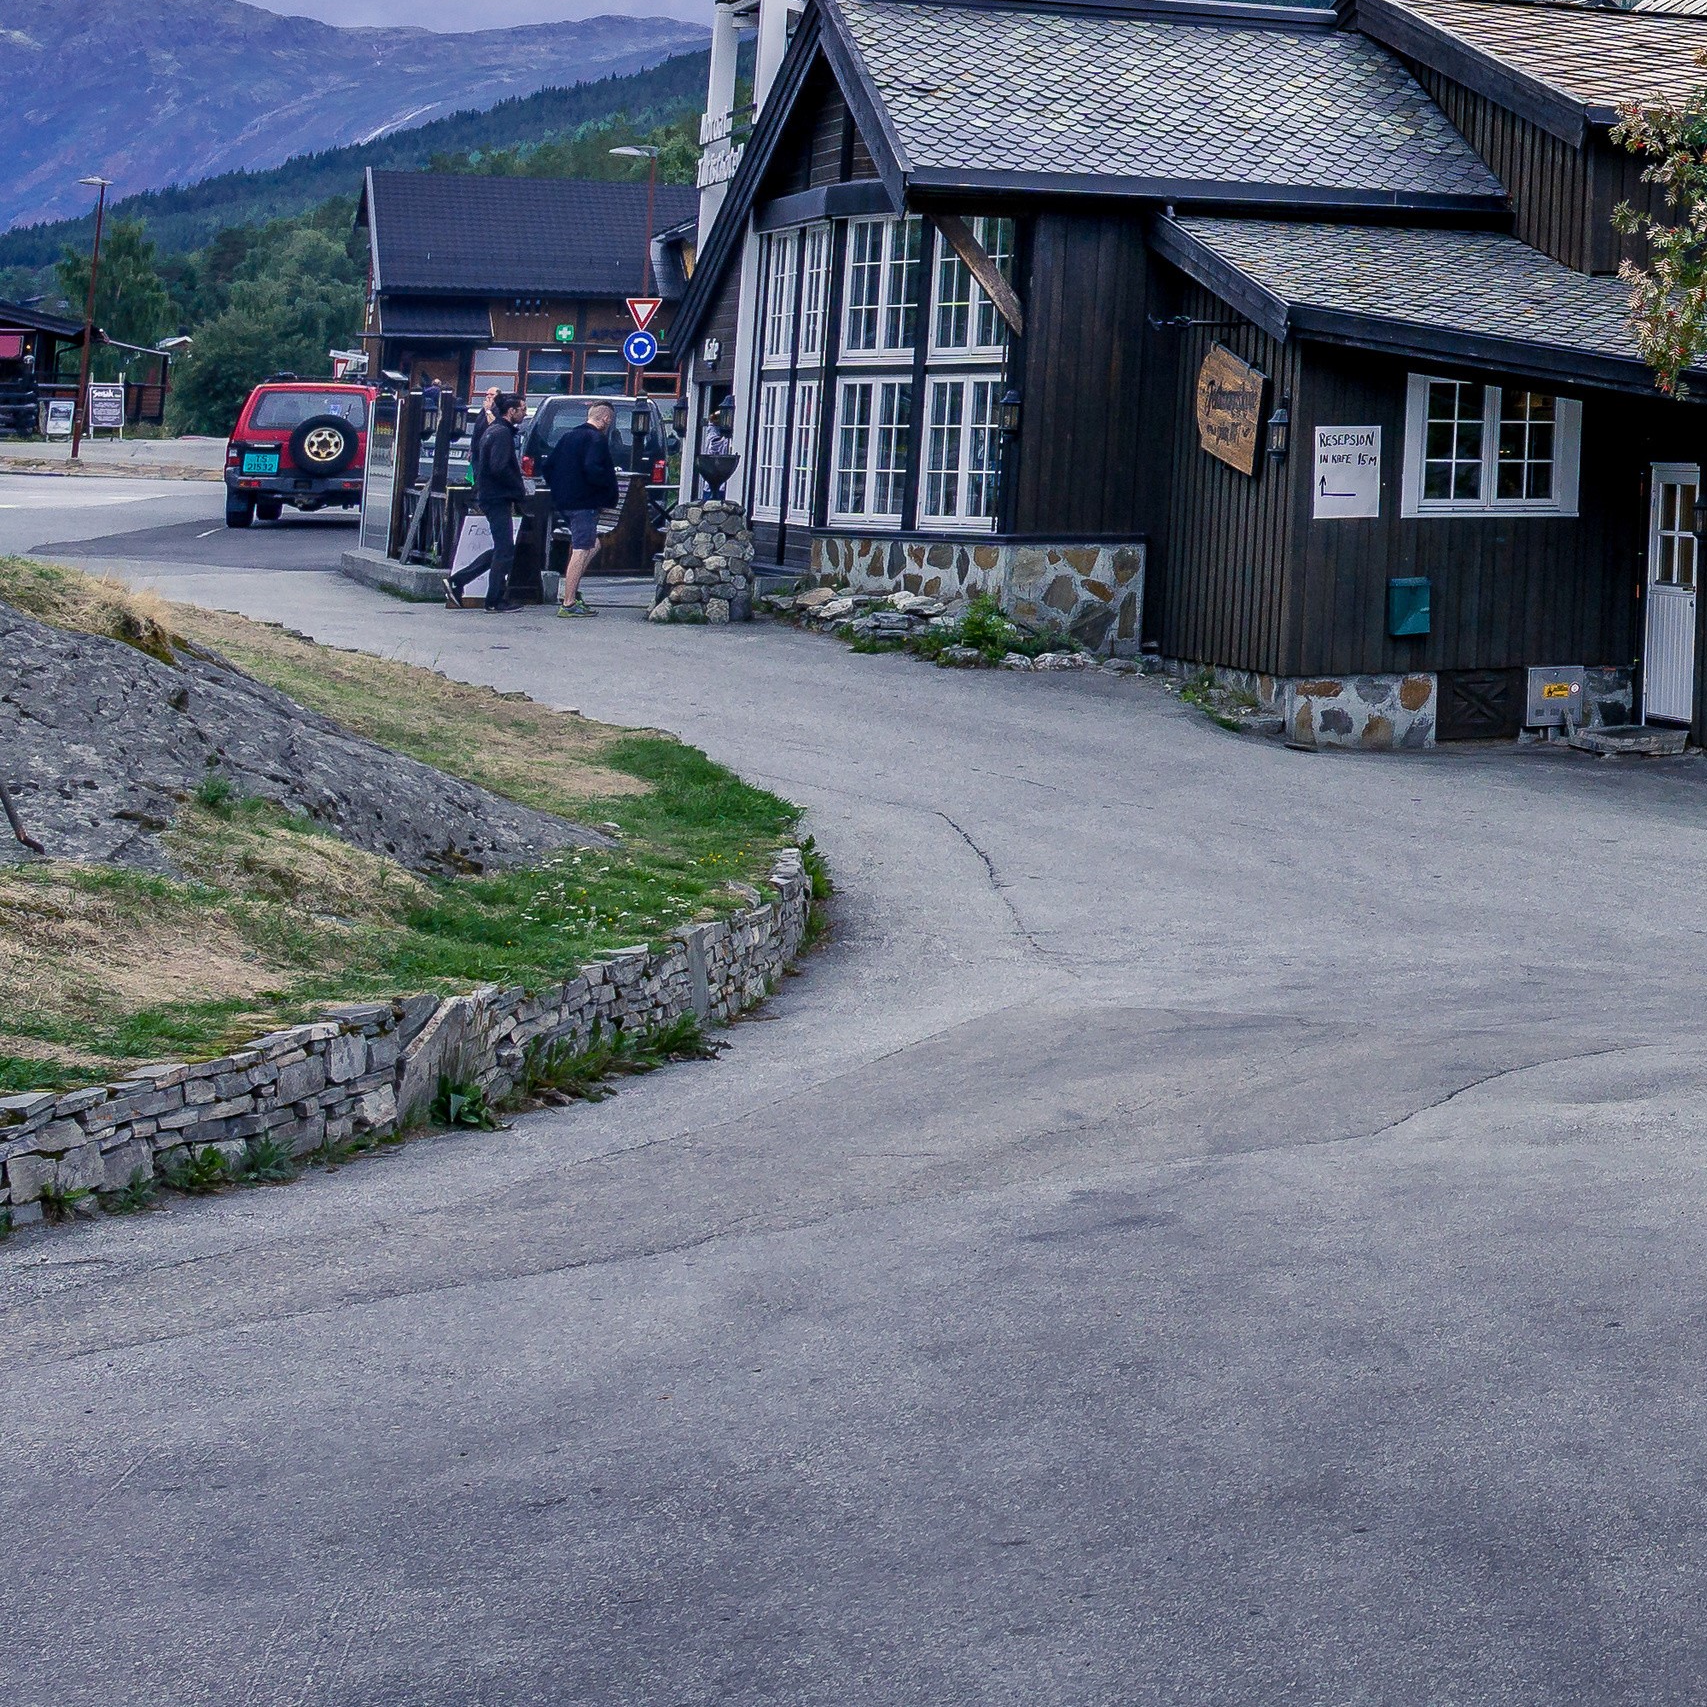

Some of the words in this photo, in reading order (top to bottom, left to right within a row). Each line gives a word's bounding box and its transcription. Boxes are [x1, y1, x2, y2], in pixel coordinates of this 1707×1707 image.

[1319, 431, 1375, 448] RESEPSJON
[1319, 453, 1329, 464] IN
[1331, 453, 1353, 464] KAFE
